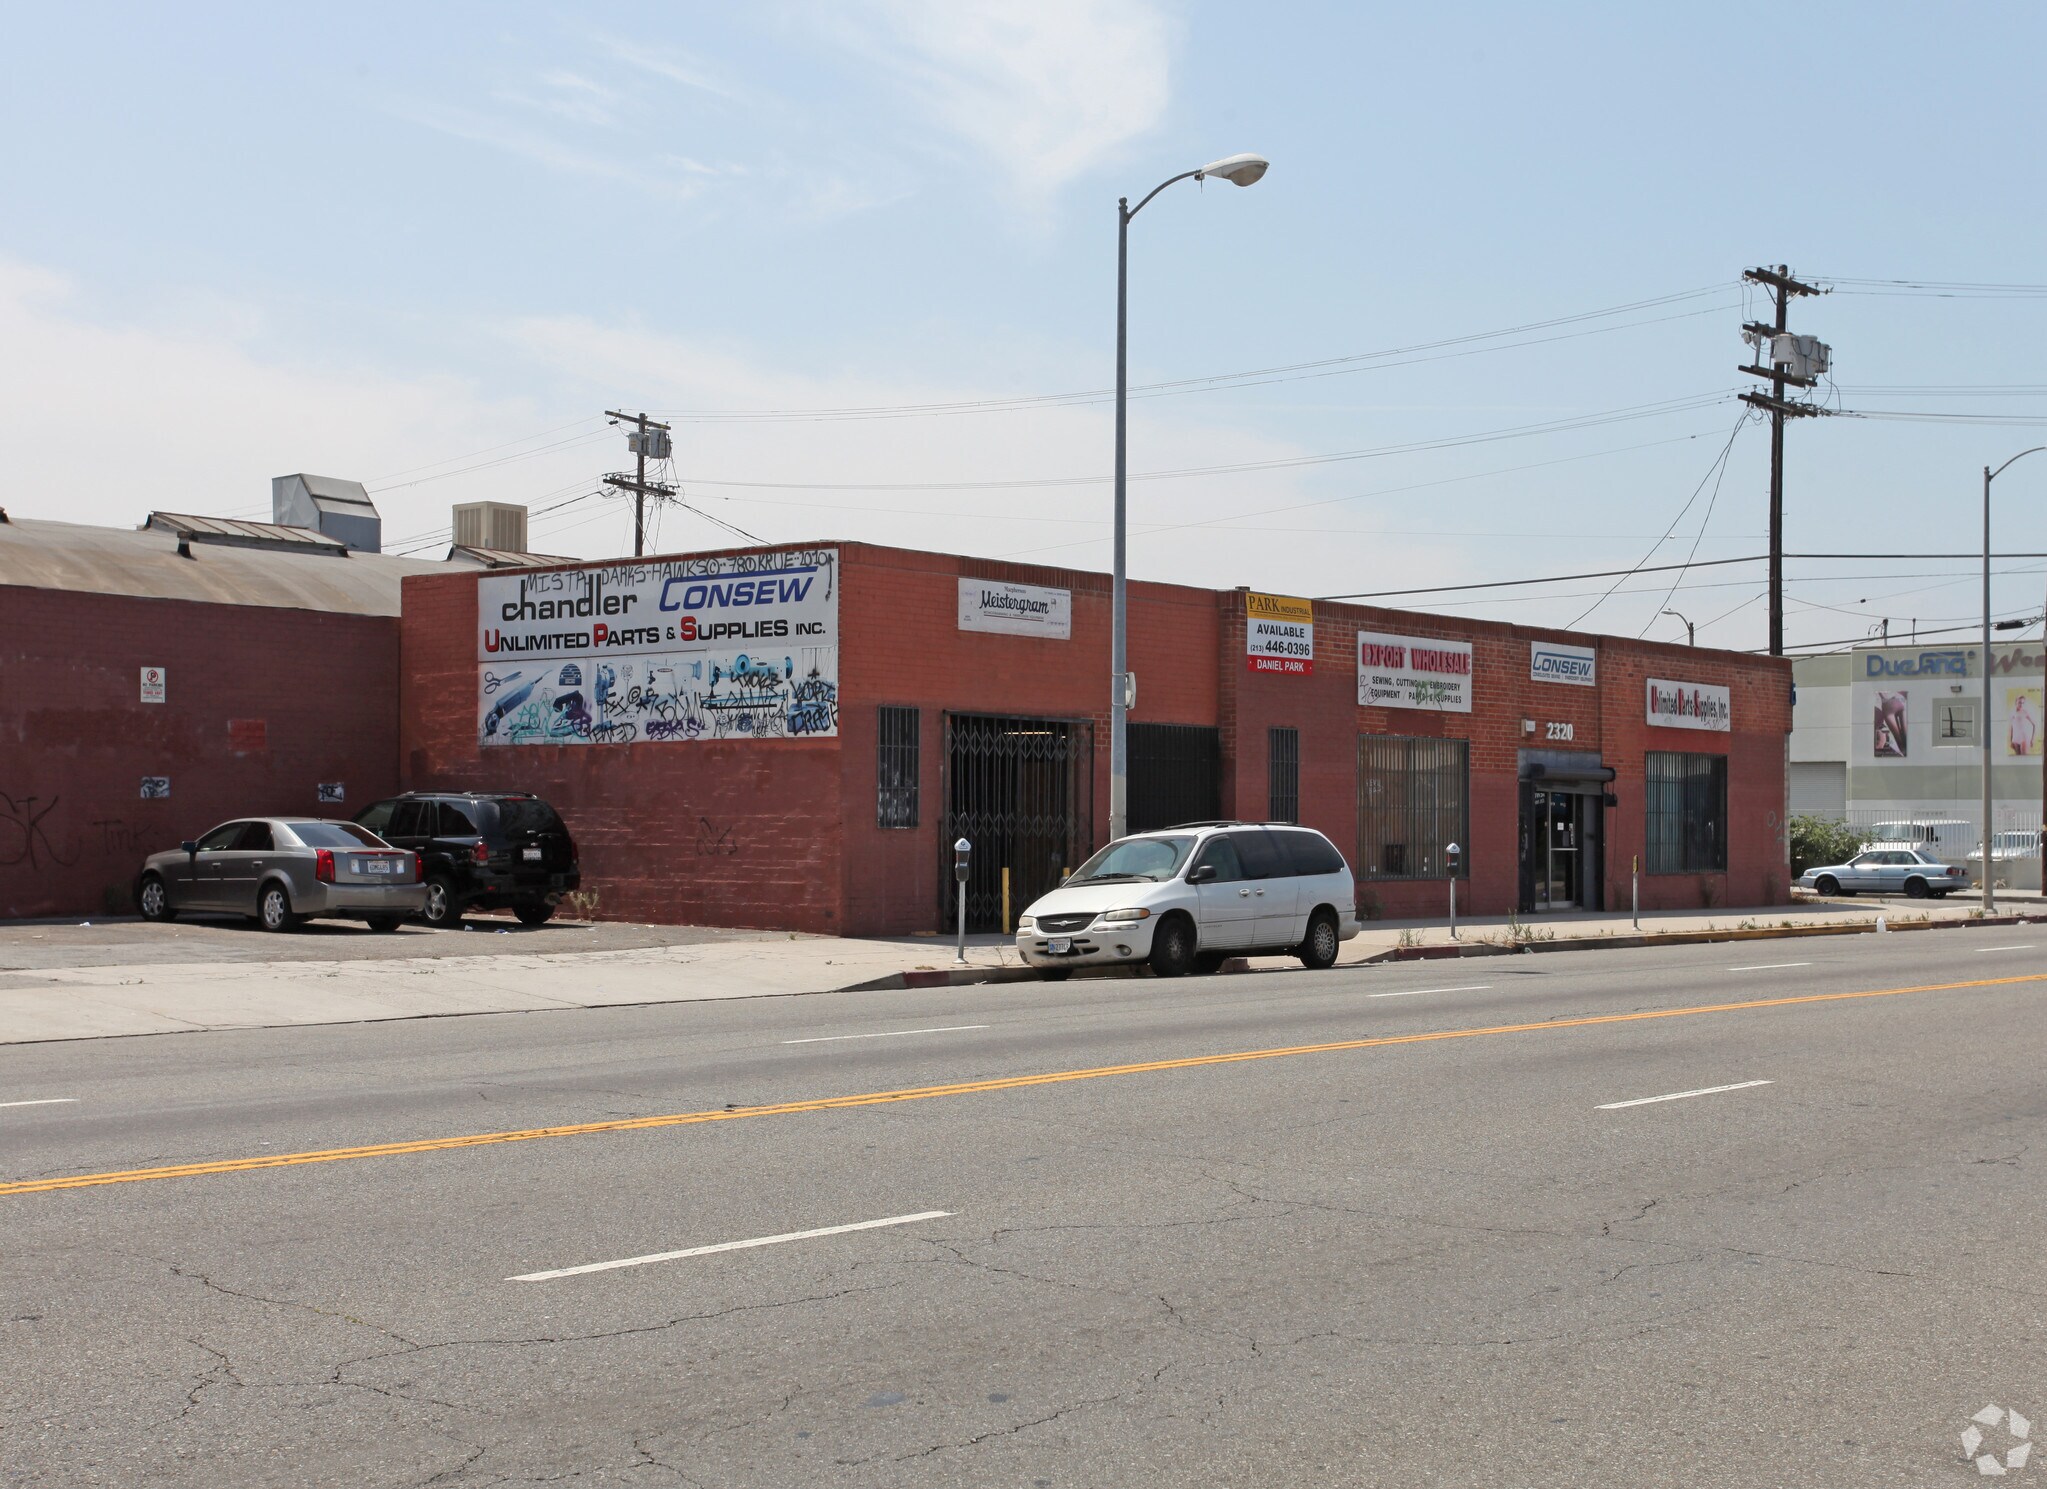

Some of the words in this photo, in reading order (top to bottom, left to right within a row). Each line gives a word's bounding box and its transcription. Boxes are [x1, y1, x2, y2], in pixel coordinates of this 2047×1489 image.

[502, 573, 638, 622] chandler
[659, 566, 819, 612] CONSEW
[978, 589, 1050, 615] Meistergram
[1248, 595, 1280, 612] PARK
[1281, 606, 1311, 616] INDUSTRIAL
[485, 627, 590, 653] UNLIMITED
[593, 623, 660, 648] PARTS
[666, 627, 676, 640] &
[680, 615, 789, 642] SUPPLIES
[796, 622, 826, 636] INC.
[1257, 623, 1305, 638] AVAILABLE
[1250, 644, 1264, 653] (213)
[1265, 640, 1310, 656] 446-0396
[1257, 659, 1283, 671] DANIEL
[1284, 661, 1304, 672] PARK
[1362, 643, 1406, 668] EXPORT
[1411, 648, 1471, 675] WHOLESALE
[1533, 651, 1594, 676] CONSEW
[1372, 676, 1395, 687] SEWING,
[1429, 681, 1461, 691] EMBROIDERY
[1371, 688, 1400, 699] EQUIPMENT
[1437, 694, 1462, 704] SUPPLIES
[1546, 722, 1574, 740] 2320
